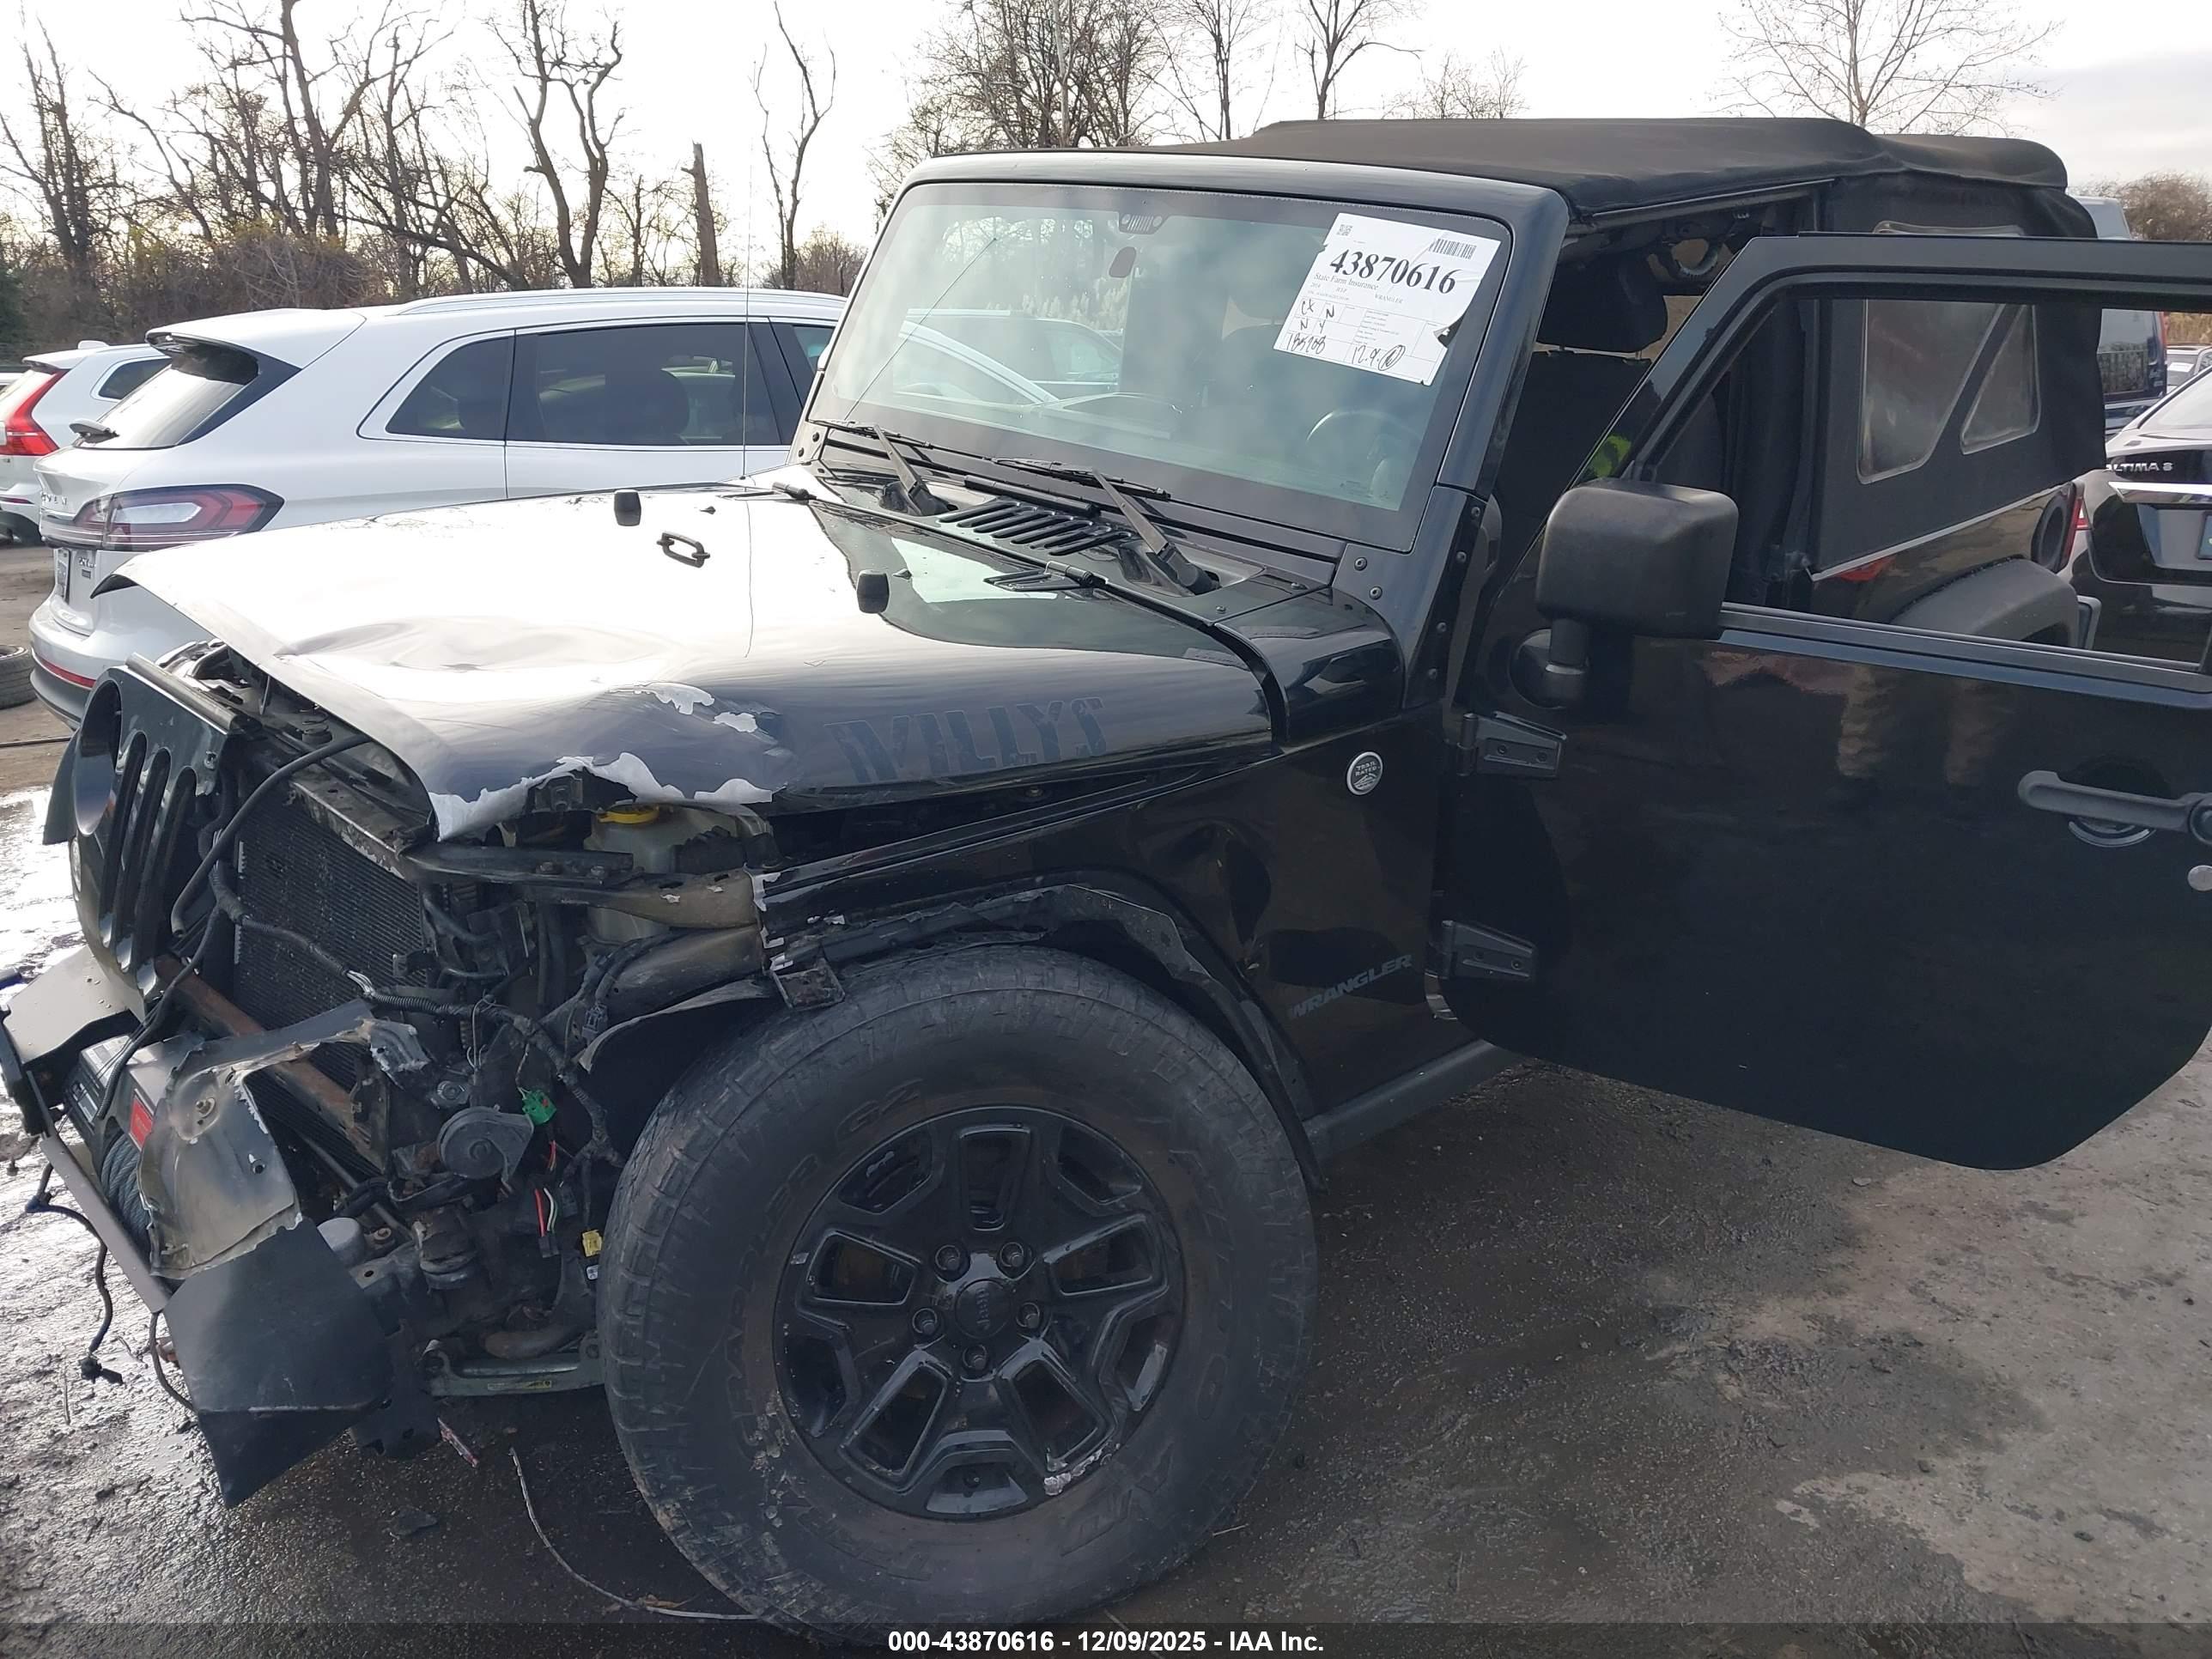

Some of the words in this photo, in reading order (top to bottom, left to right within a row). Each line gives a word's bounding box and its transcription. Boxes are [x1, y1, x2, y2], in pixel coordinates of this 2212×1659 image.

[1314, 272, 1330, 282] State
[1330, 276, 1347, 285] Farm
[1348, 278, 1379, 290] Insurance
[1329, 249, 1463, 294] 43870616
[823, 696, 1107, 784] WILLYS
[1290, 954, 1413, 1019] WRANGLER
